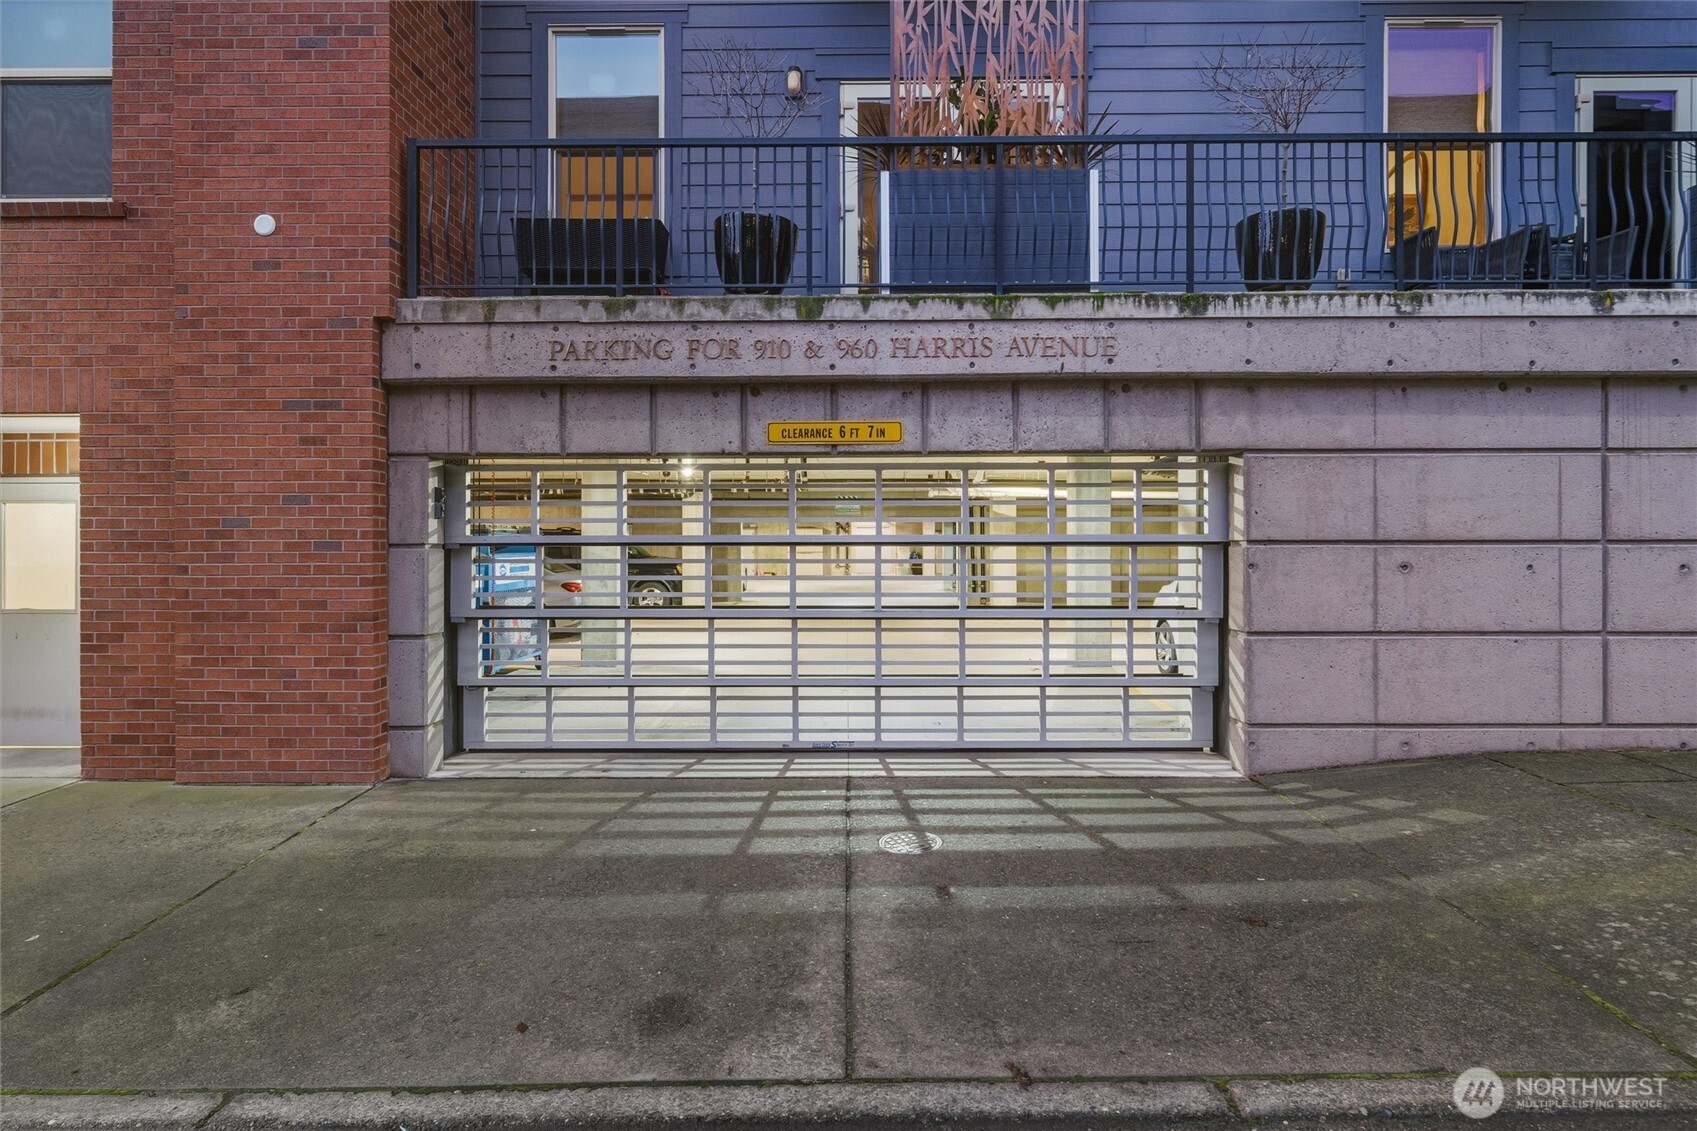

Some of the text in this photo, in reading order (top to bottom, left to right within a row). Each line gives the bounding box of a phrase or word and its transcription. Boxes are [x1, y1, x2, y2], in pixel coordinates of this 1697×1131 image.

[548, 336, 1118, 361] PARKING FOR 910 & 960 HARRIS AVENUE
[781, 425, 886, 439] CLEARANCE 6 FT 7 IN
